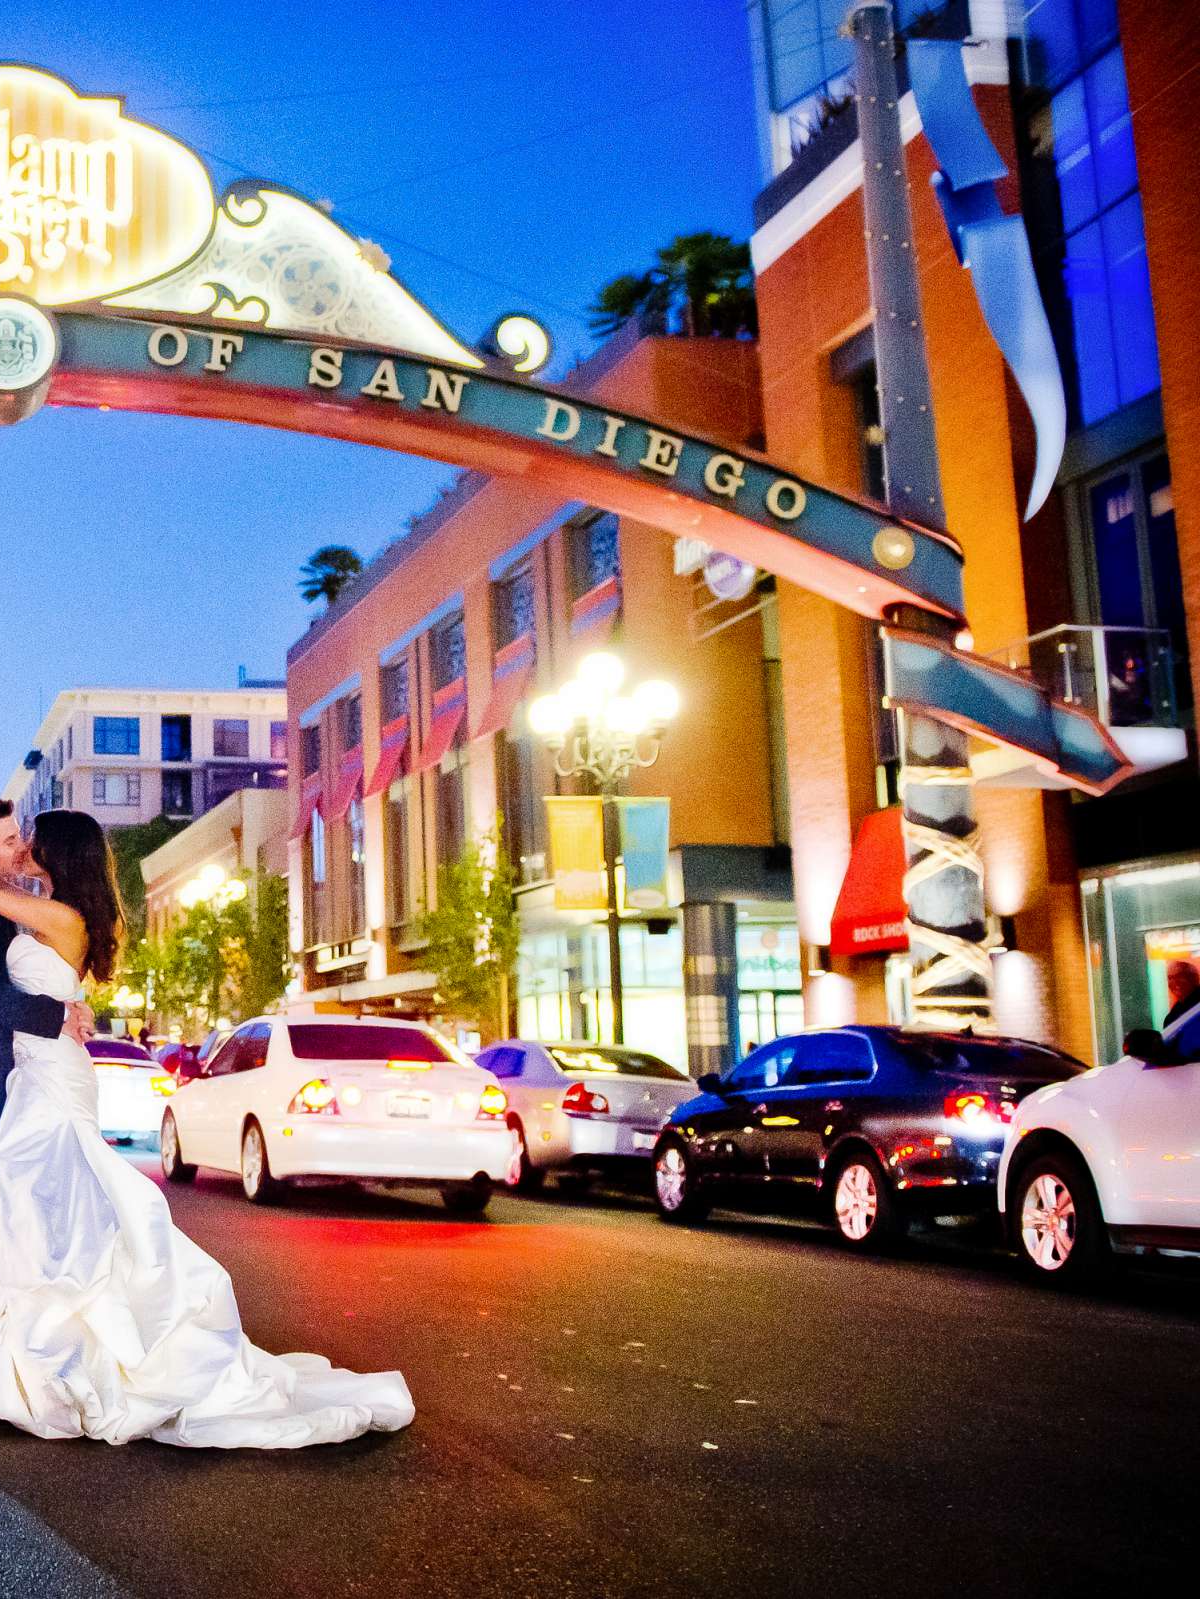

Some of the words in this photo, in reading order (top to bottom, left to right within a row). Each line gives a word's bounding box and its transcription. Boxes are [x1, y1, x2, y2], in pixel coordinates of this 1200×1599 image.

[147, 326, 244, 373] OF
[308, 347, 471, 413] SAN
[536, 397, 807, 520] DIEGO
[882, 921, 907, 939] SHO
